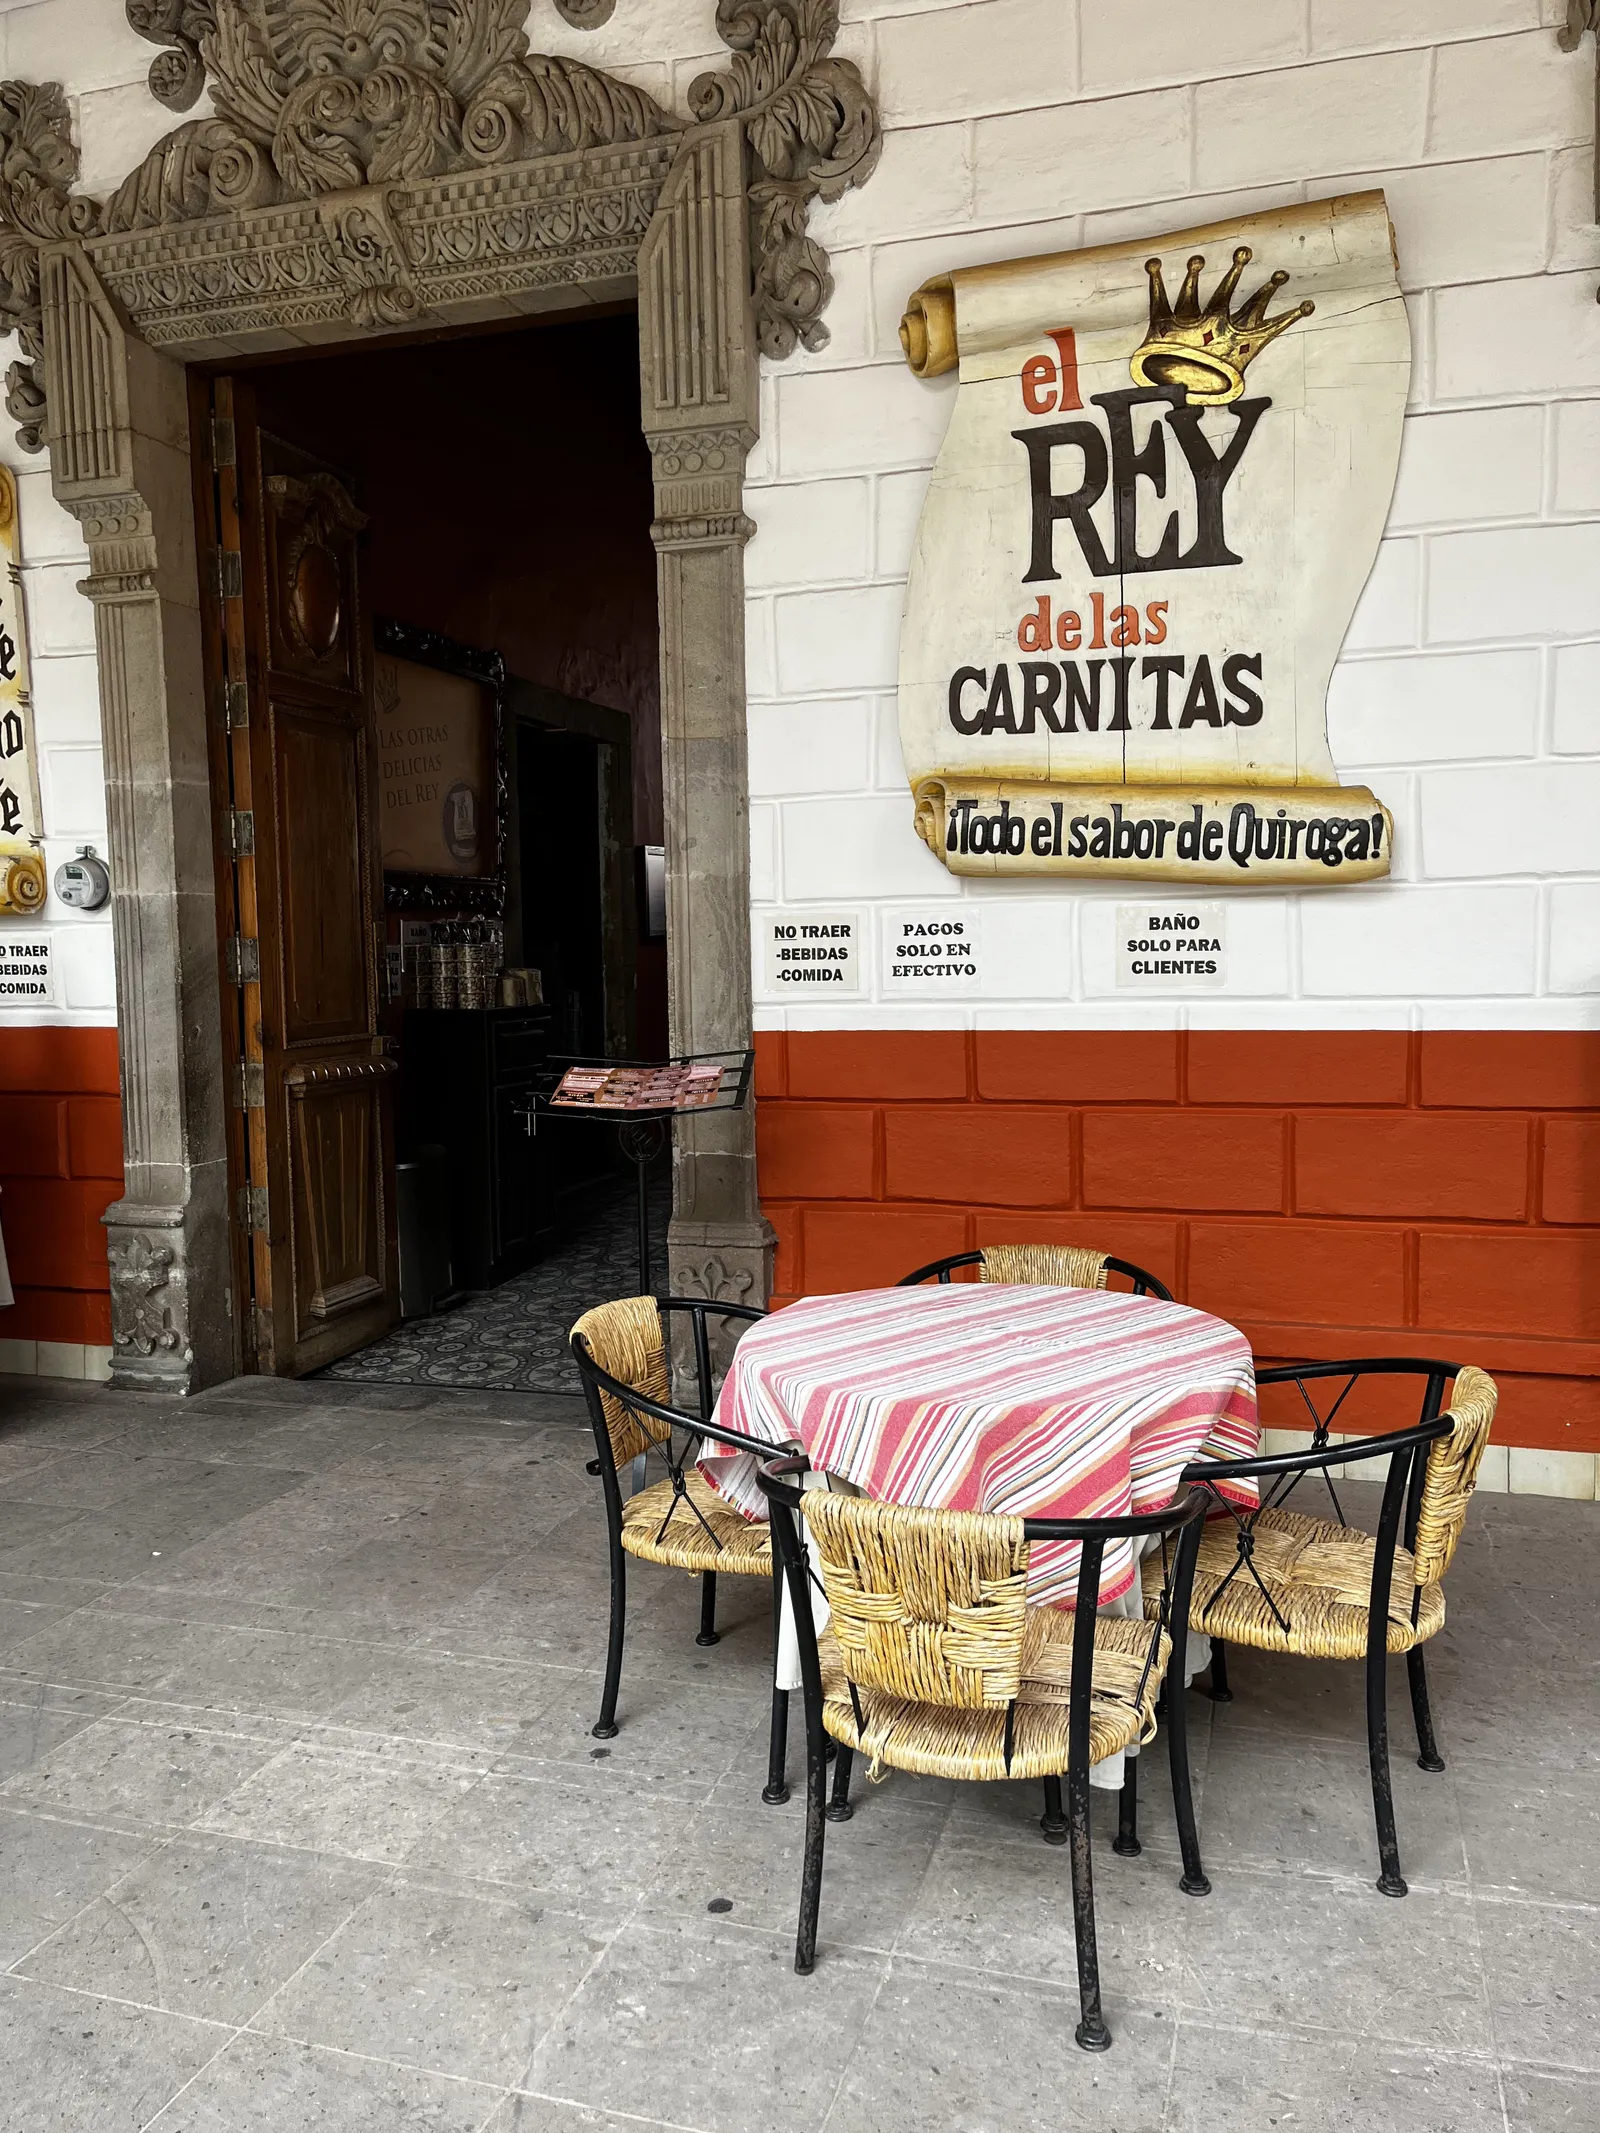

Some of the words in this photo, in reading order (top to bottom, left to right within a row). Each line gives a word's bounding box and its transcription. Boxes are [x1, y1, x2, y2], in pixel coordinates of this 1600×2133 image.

[1021, 327, 1083, 414] el
[1011, 384, 1272, 583] REY
[949, 652, 1265, 736] CARNITAS
[380, 729, 403, 749] LAS
[408, 725, 449, 746] OTRAS
[382, 755, 442, 779] DELICIAS
[386, 789, 412, 809] DEL
[947, 800, 1026, 856] ¡Todo
[1036, 802, 1064, 857] el
[1068, 803, 1175, 859] sabor
[1178, 804, 1224, 860] de
[1228, 803, 1385, 867] Quiroga!
[903, 922, 964, 937] PAGOS
[1149, 913, 1200, 931] BAÑO
[774, 925, 797, 939] NO
[800, 924, 852, 939] TRAER
[9, 945, 49, 957] TRAER
[896, 943, 942, 957] SOLO
[946, 943, 971, 956] EN
[1127, 939, 1171, 953] SOLO
[1175, 938, 1221, 952] PARA
[776, 947, 849, 961] -BEBIDAS
[776, 968, 844, 982] -COMIDA
[892, 963, 976, 977] EFECTIVO
[1131, 959, 1217, 975] CLIENTES
